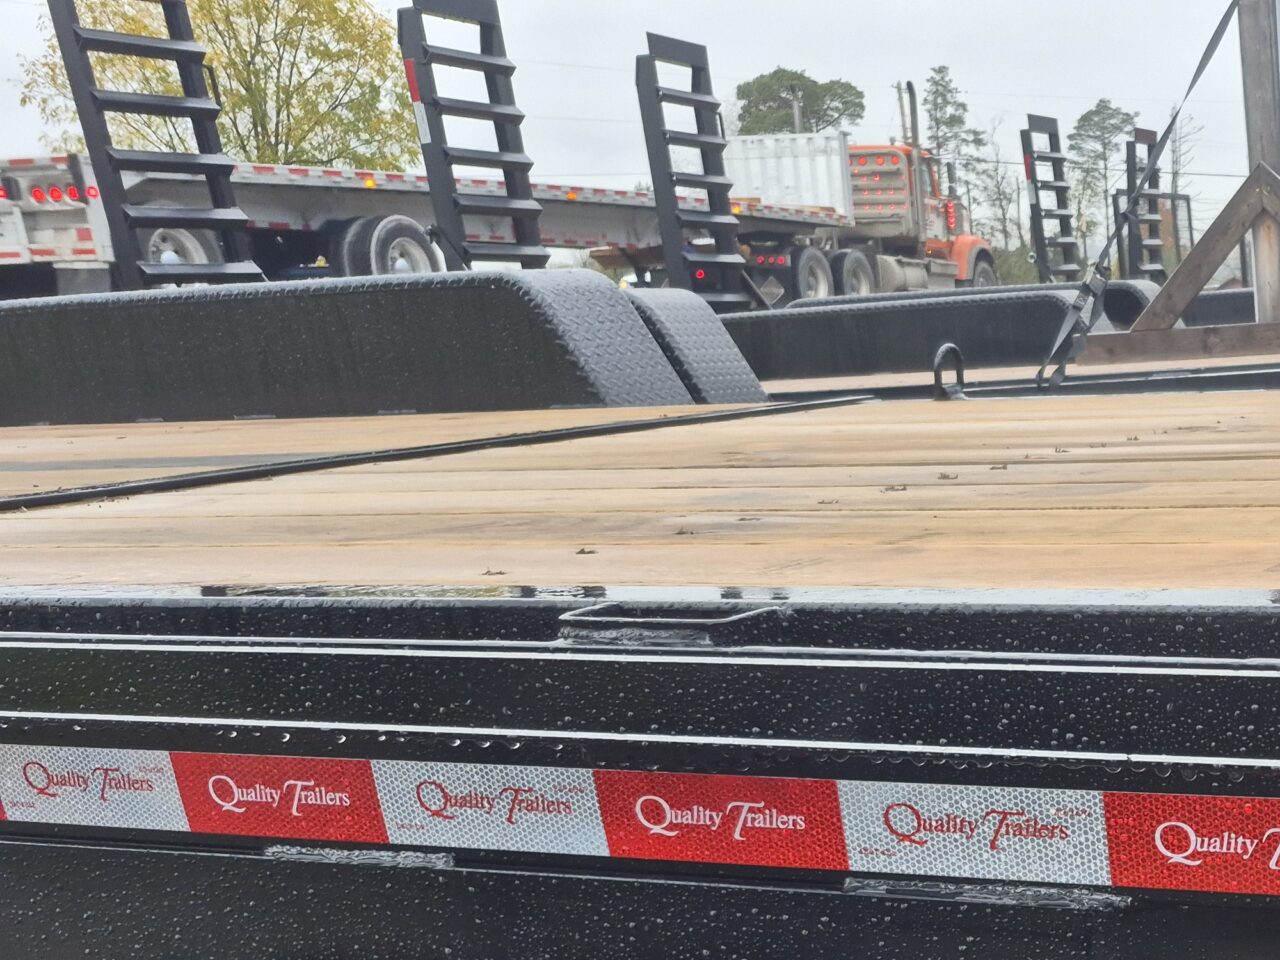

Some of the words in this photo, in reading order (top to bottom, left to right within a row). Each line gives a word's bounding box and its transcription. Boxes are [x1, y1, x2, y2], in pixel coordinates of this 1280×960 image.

[22, 761, 90, 797] Quality
[92, 767, 154, 800] Trailers
[208, 775, 281, 813] Quality
[283, 779, 350, 816] Trailers
[415, 780, 495, 820] Quality
[500, 786, 572, 824] Trailers
[634, 795, 723, 837] Quality
[725, 800, 806, 840] Trailers
[882, 802, 979, 846] Quality
[982, 808, 1069, 849] Trailers
[1154, 821, 1259, 865] Quality
